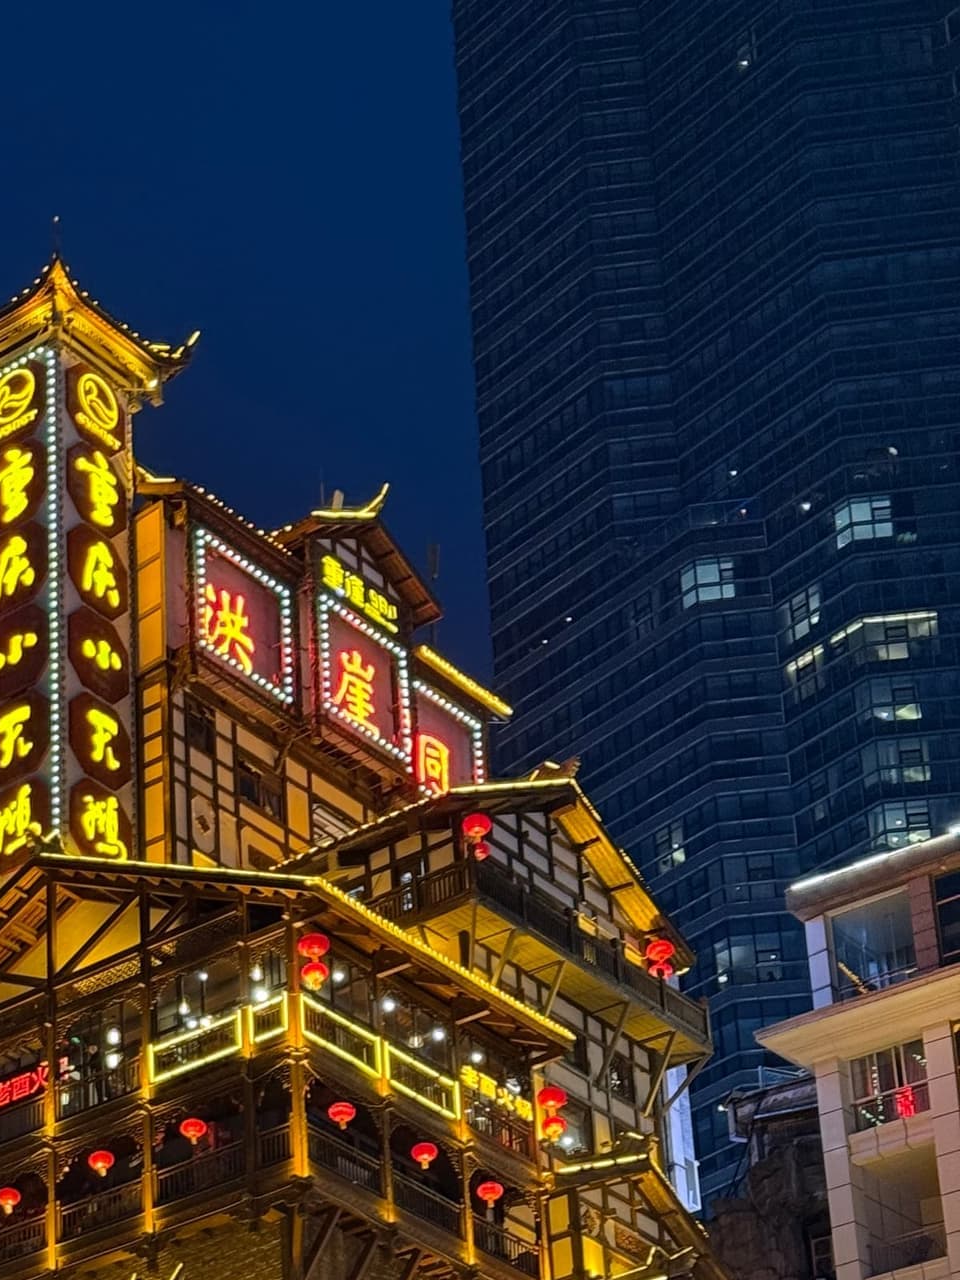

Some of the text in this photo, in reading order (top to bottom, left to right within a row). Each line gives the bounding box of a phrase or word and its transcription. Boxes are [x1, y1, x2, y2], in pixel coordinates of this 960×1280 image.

[76, 451, 127, 861] 重庆小天鹅
